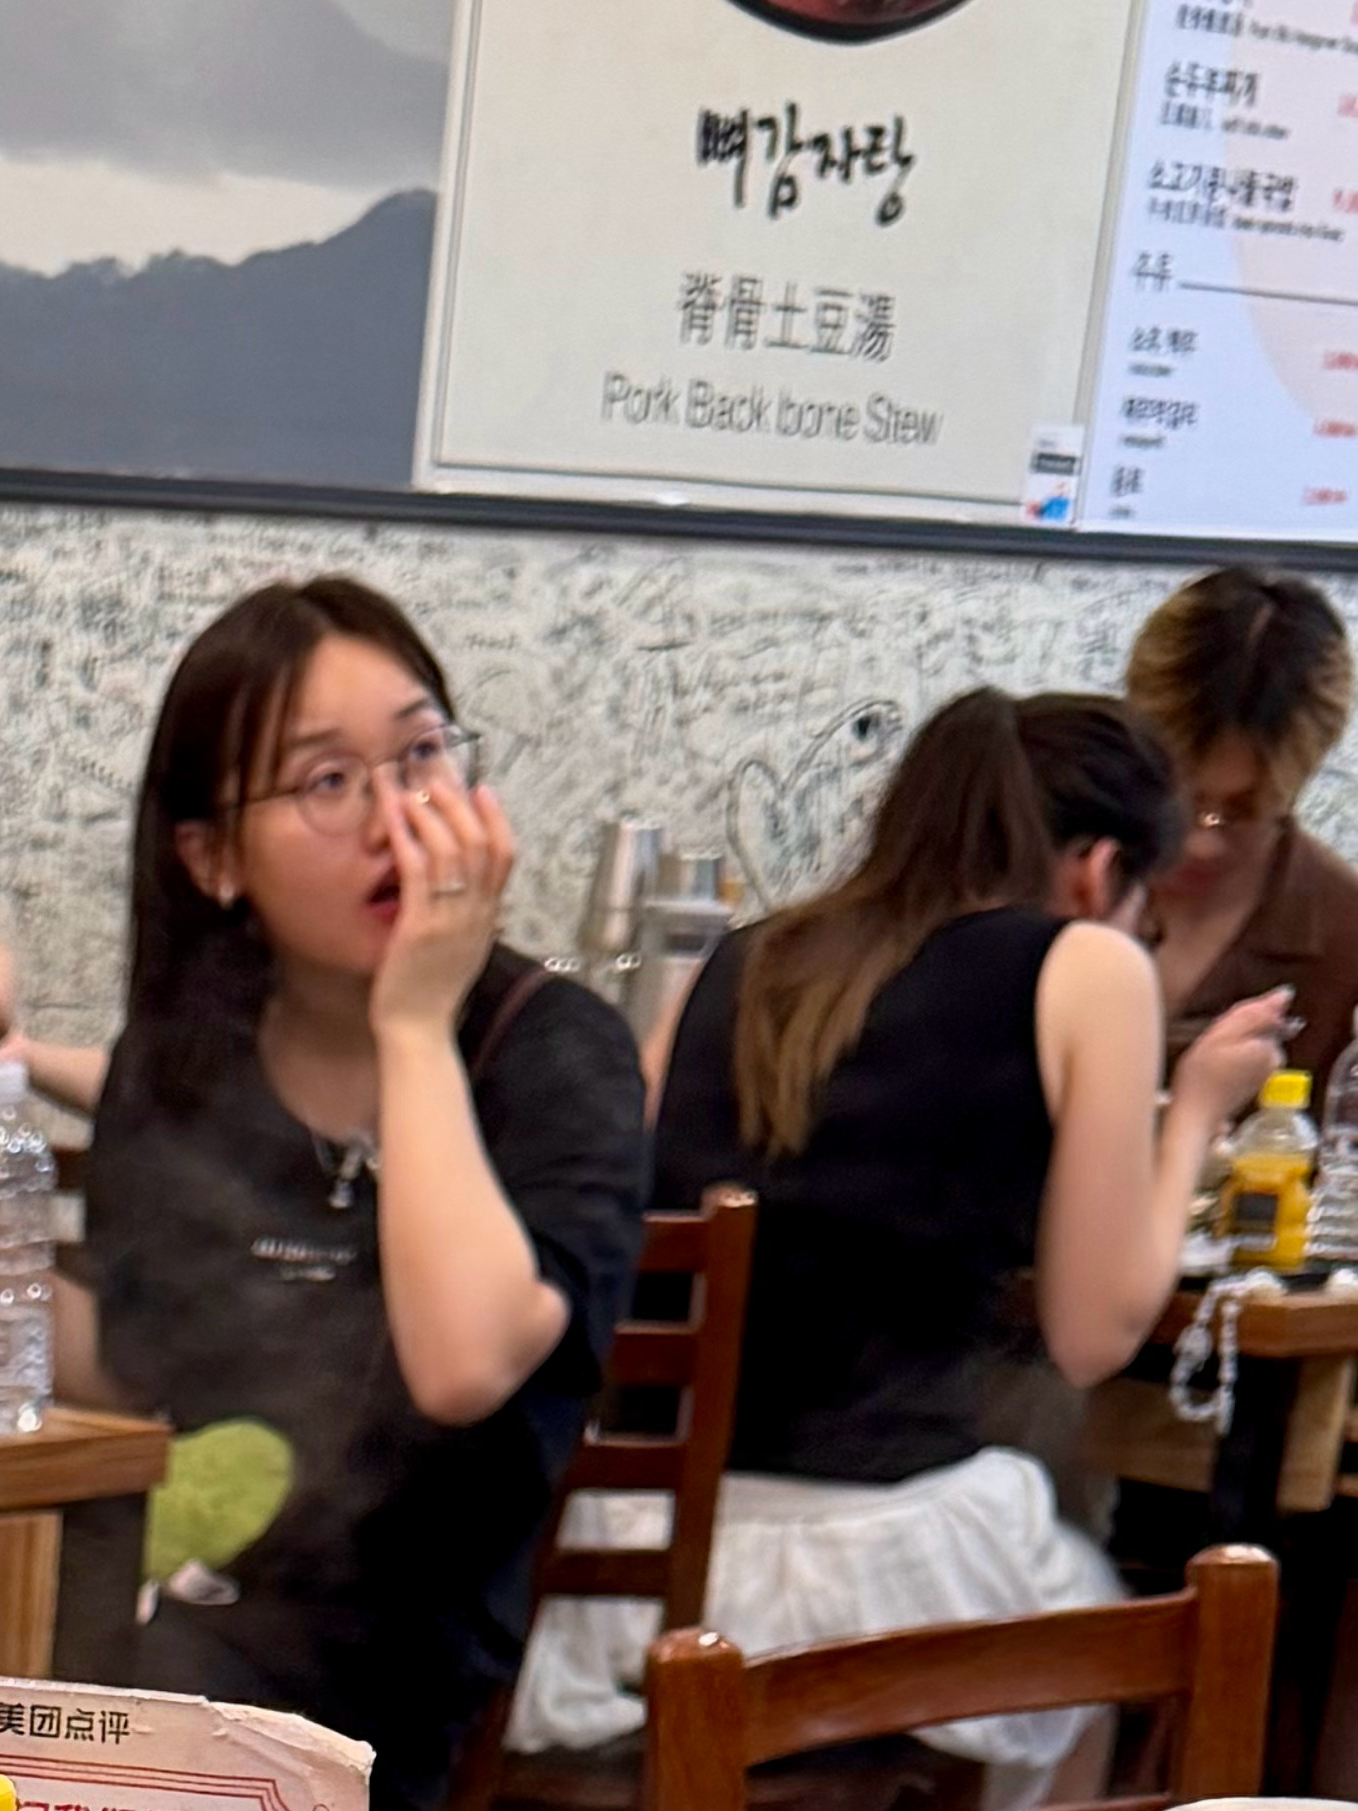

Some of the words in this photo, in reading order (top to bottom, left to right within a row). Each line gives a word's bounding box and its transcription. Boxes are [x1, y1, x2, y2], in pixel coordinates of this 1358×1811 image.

[602, 370, 680, 425] Pork
[684, 377, 771, 433] Back
[862, 391, 944, 446] Stew
